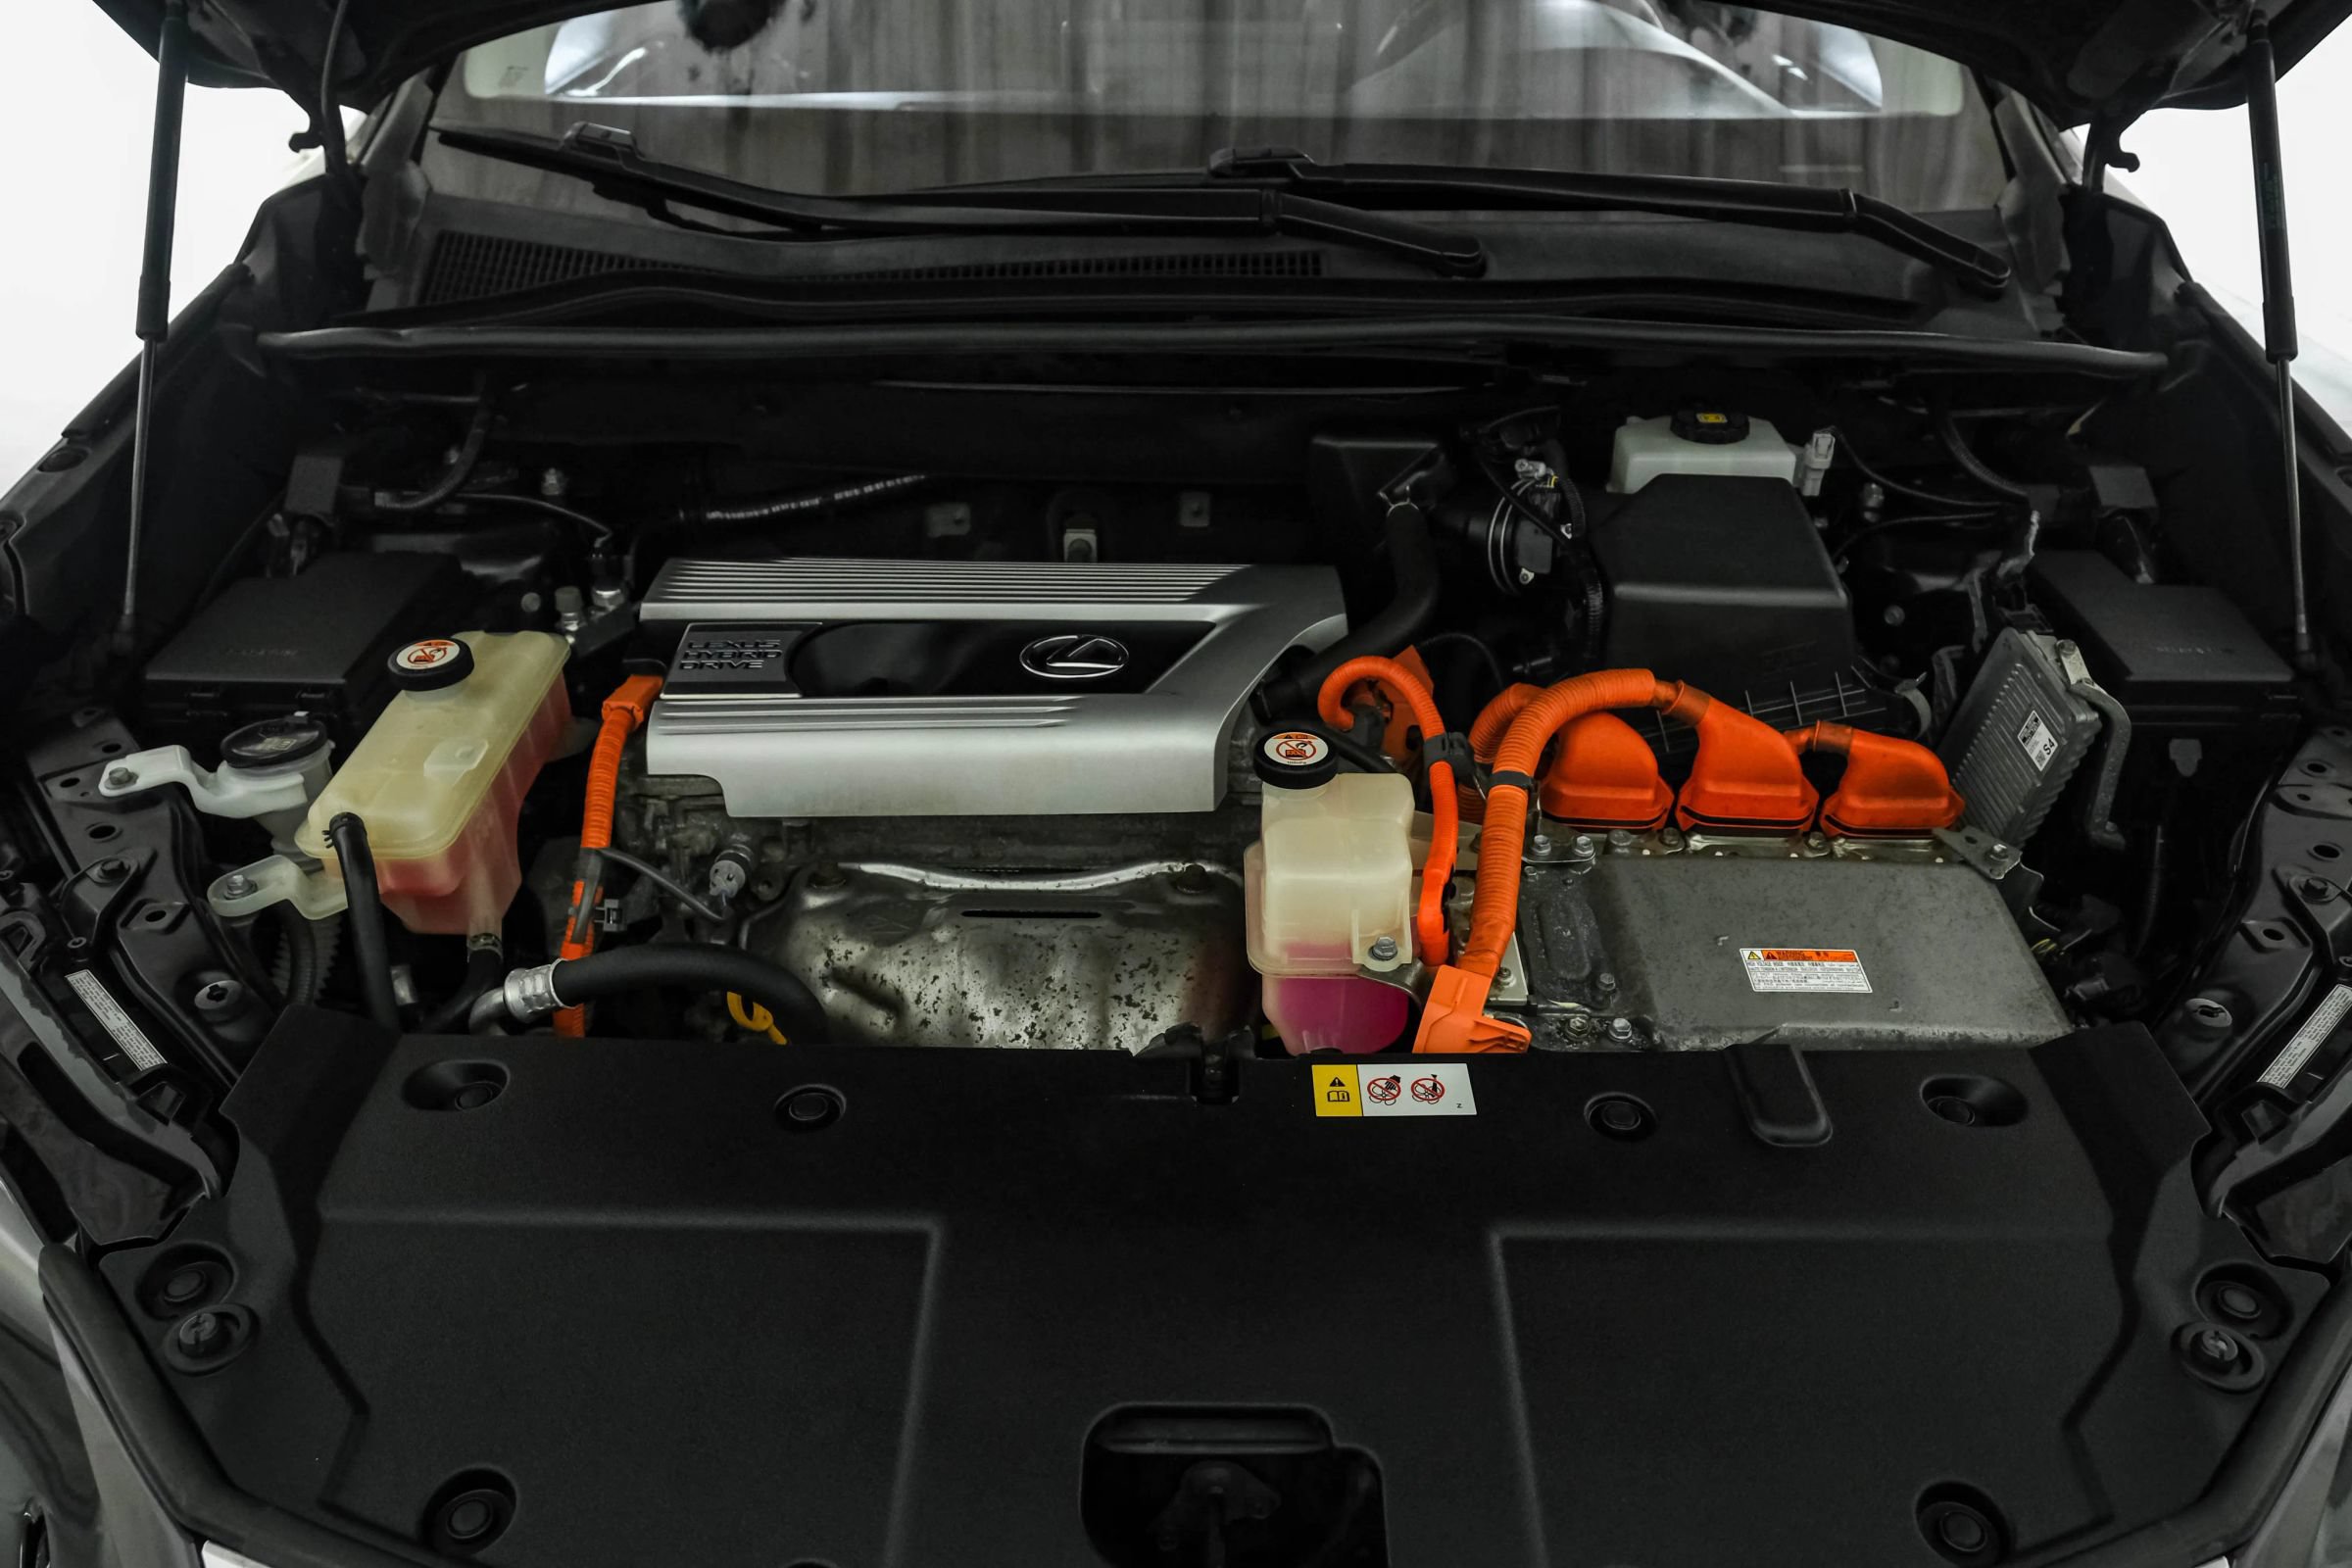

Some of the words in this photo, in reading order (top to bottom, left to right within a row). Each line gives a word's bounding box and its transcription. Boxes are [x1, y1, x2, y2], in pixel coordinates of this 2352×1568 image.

[688, 640, 781, 649] LEXUS
[683, 650, 783, 659] HYBRID
[679, 660, 764, 670] DRIVE
